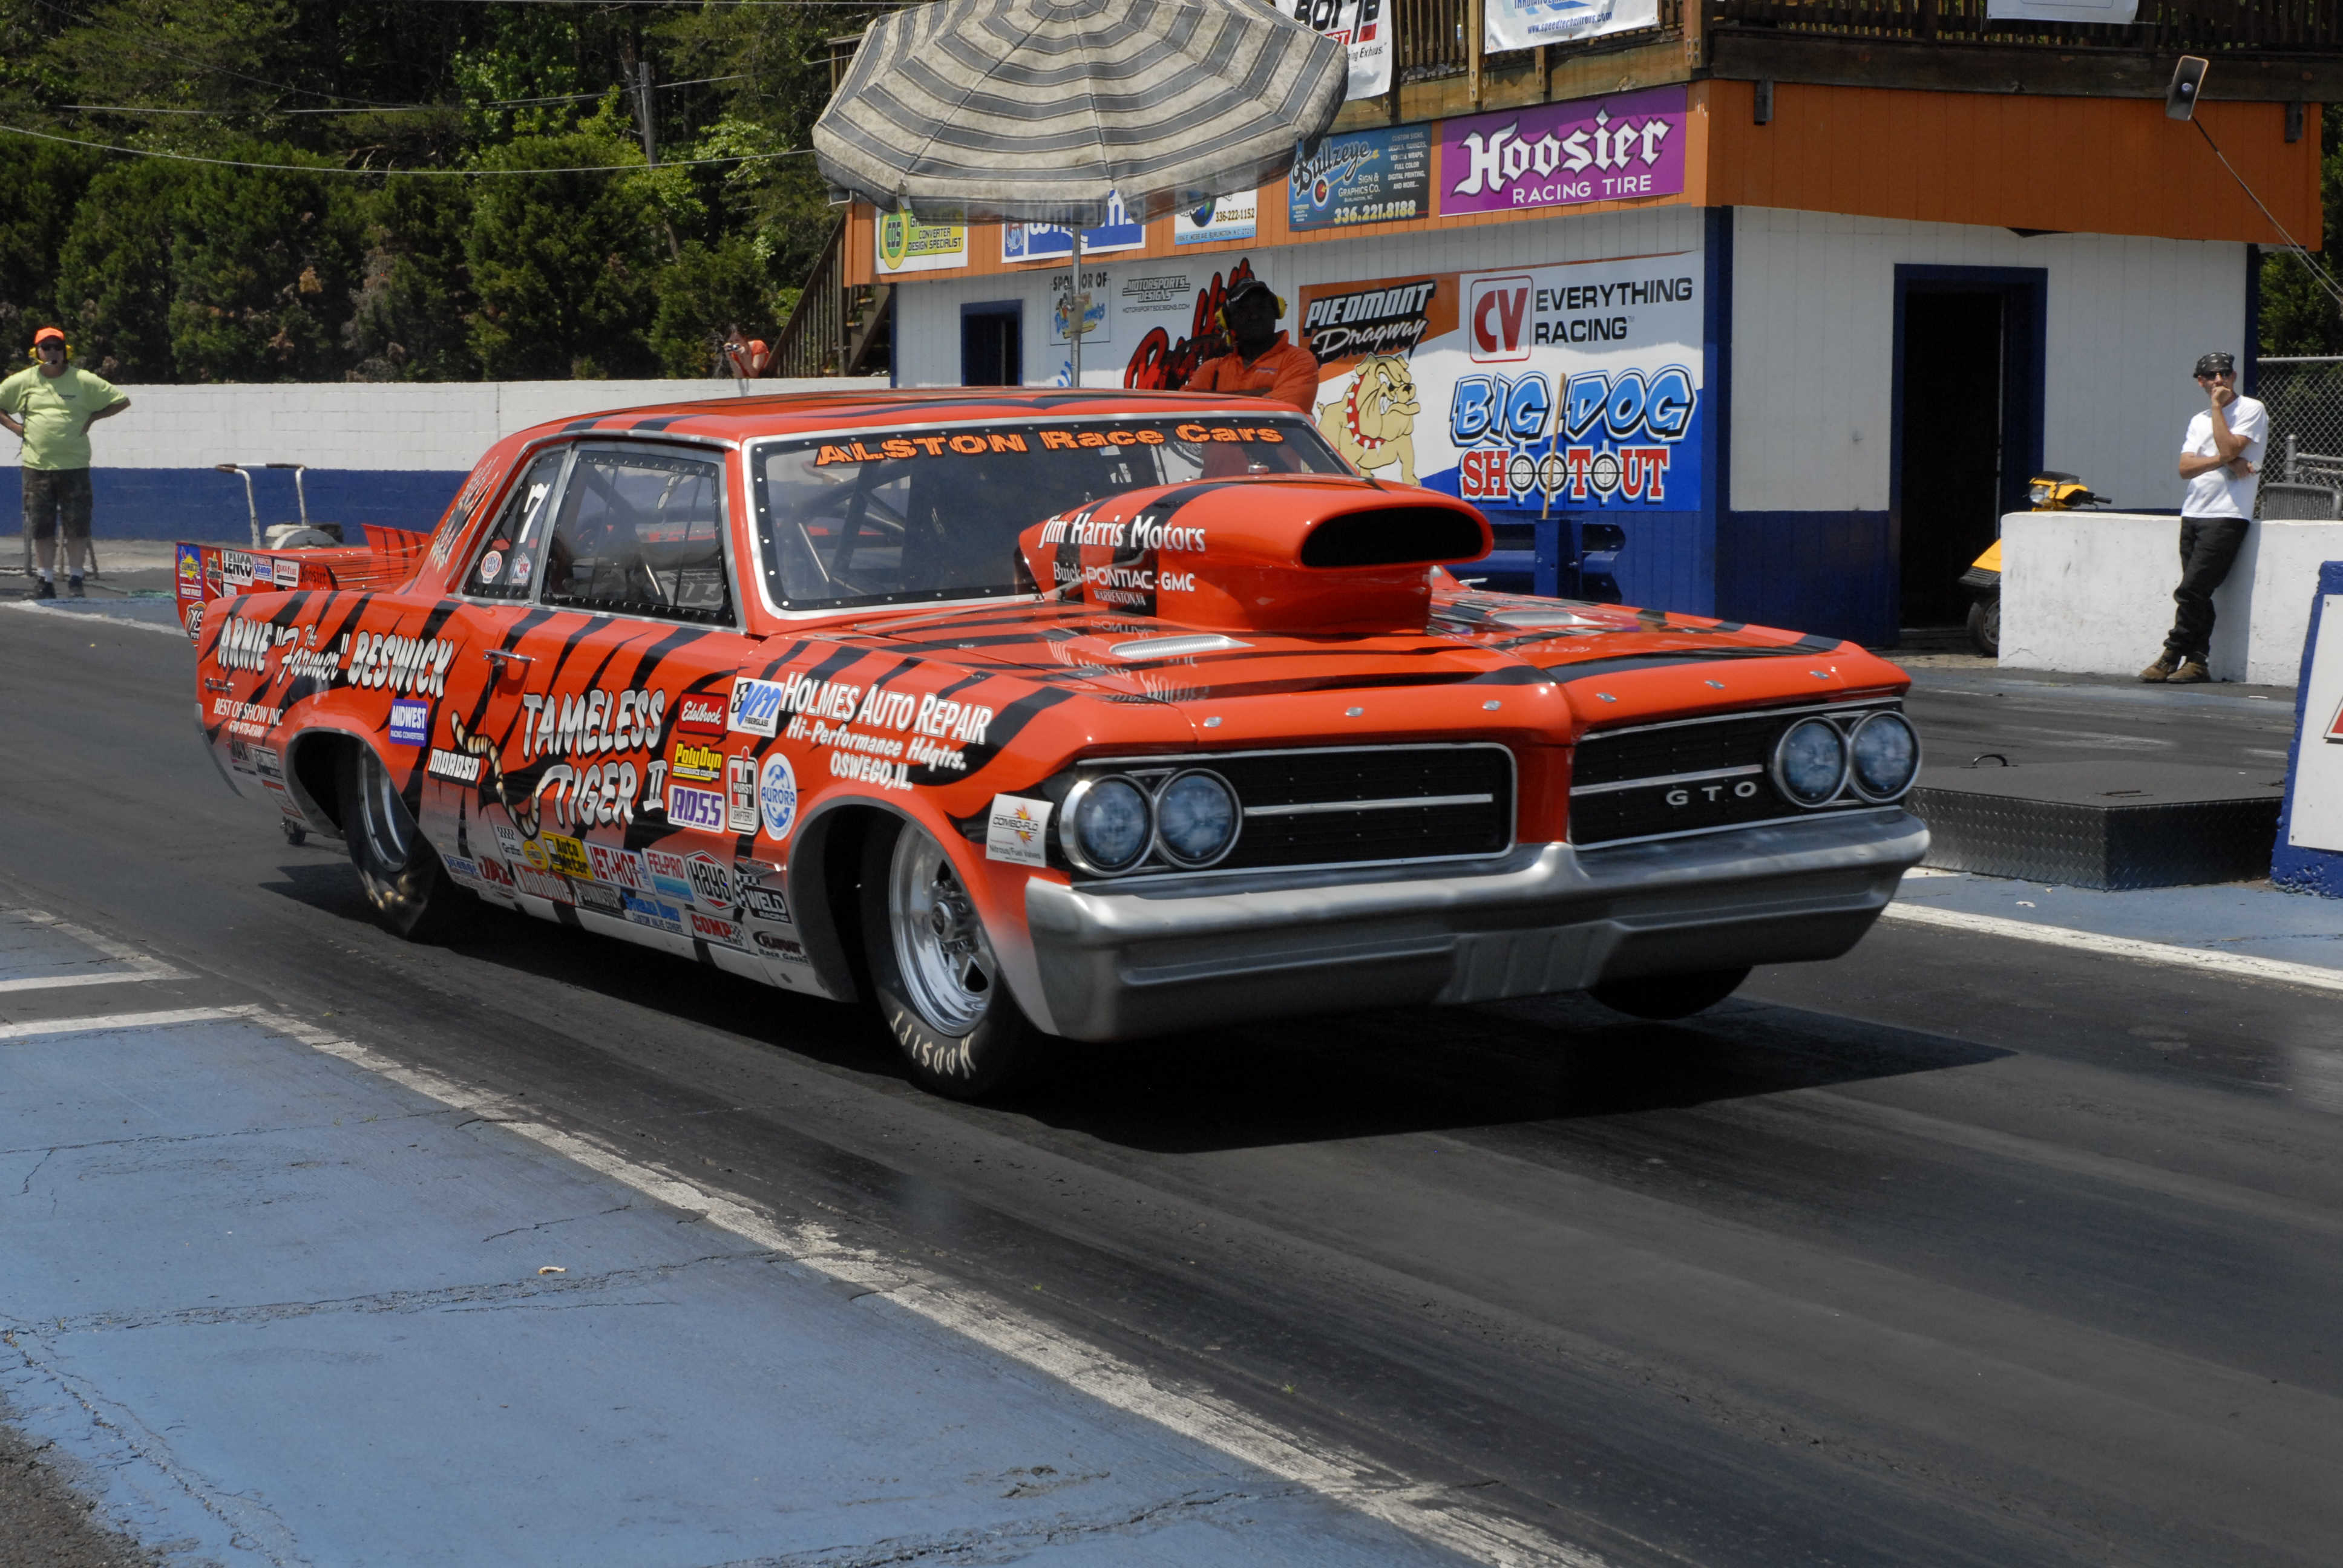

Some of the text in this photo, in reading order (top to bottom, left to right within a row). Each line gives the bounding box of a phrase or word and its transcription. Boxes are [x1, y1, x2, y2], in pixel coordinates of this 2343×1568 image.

[1451, 104, 1674, 197] Hoosier
[1293, 140, 1371, 198] Bullzeye
[1358, 172, 1379, 184] SIGN &
[1339, 186, 1368, 197] GRAPHICS
[1513, 174, 1651, 204] RACING TIRE
[1215, 208, 1255, 223] 336-222-1152
[1334, 200, 1416, 224] 336.221.8188
[908, 237, 962, 251] DESIGN SPECIALIST
[919, 227, 951, 240] CONVERTER
[1053, 272, 1107, 291] SPOOR OF
[1127, 276, 1187, 291] MOTORSPORTS
[1536, 277, 1693, 312] EVERYTHING
[1122, 303, 1190, 314] MOTORSPORTSDESIGNS.COM
[1304, 283, 1434, 328] PIEDMONT
[1474, 287, 1529, 353] CV
[1535, 316, 1628, 345] RACING
[1312, 319, 1428, 357] Dragway
[1450, 364, 1697, 446] BIG DOG
[814, 423, 1287, 465] ALSTON Race Cars
[1459, 442, 1671, 502] SHOOTOUT
[1037, 512, 1206, 552] Jim Harris Motors
[223, 551, 252, 578] LENCO
[217, 616, 273, 672] ARNIE
[347, 631, 454, 698] BESWICK
[214, 697, 283, 726] BEST OF SHOW INC.
[390, 704, 427, 730] MIDWEST
[681, 700, 723, 725] Edelbrock
[744, 716, 769, 727] FIBERGLASS
[779, 671, 993, 745] HOLMES AUTO REPAIR
[390, 730, 425, 740] RACING CONVERTERS
[523, 689, 666, 757] TAMELESS
[787, 715, 967, 772] Hi-Performance Hdqtrs.
[428, 748, 480, 781] MOROSO
[674, 743, 723, 772] PolyDyn
[540, 760, 638, 826] TIGER
[733, 782, 753, 795] HURST
[761, 786, 796, 807] AURORA
[670, 787, 723, 827] ROSS
[732, 809, 753, 823] SHIFTERS
[992, 817, 1038, 832] COMBO-FLO
[555, 837, 579, 858] Auto
[557, 853, 588, 875] Meter
[589, 845, 642, 889] JET-HOT
[647, 852, 684, 880] FEL-PRO
[744, 889, 787, 913] WELD
[690, 913, 732, 937] COMP
[759, 911, 788, 921] RACING
[723, 935, 744, 947] CAMS
